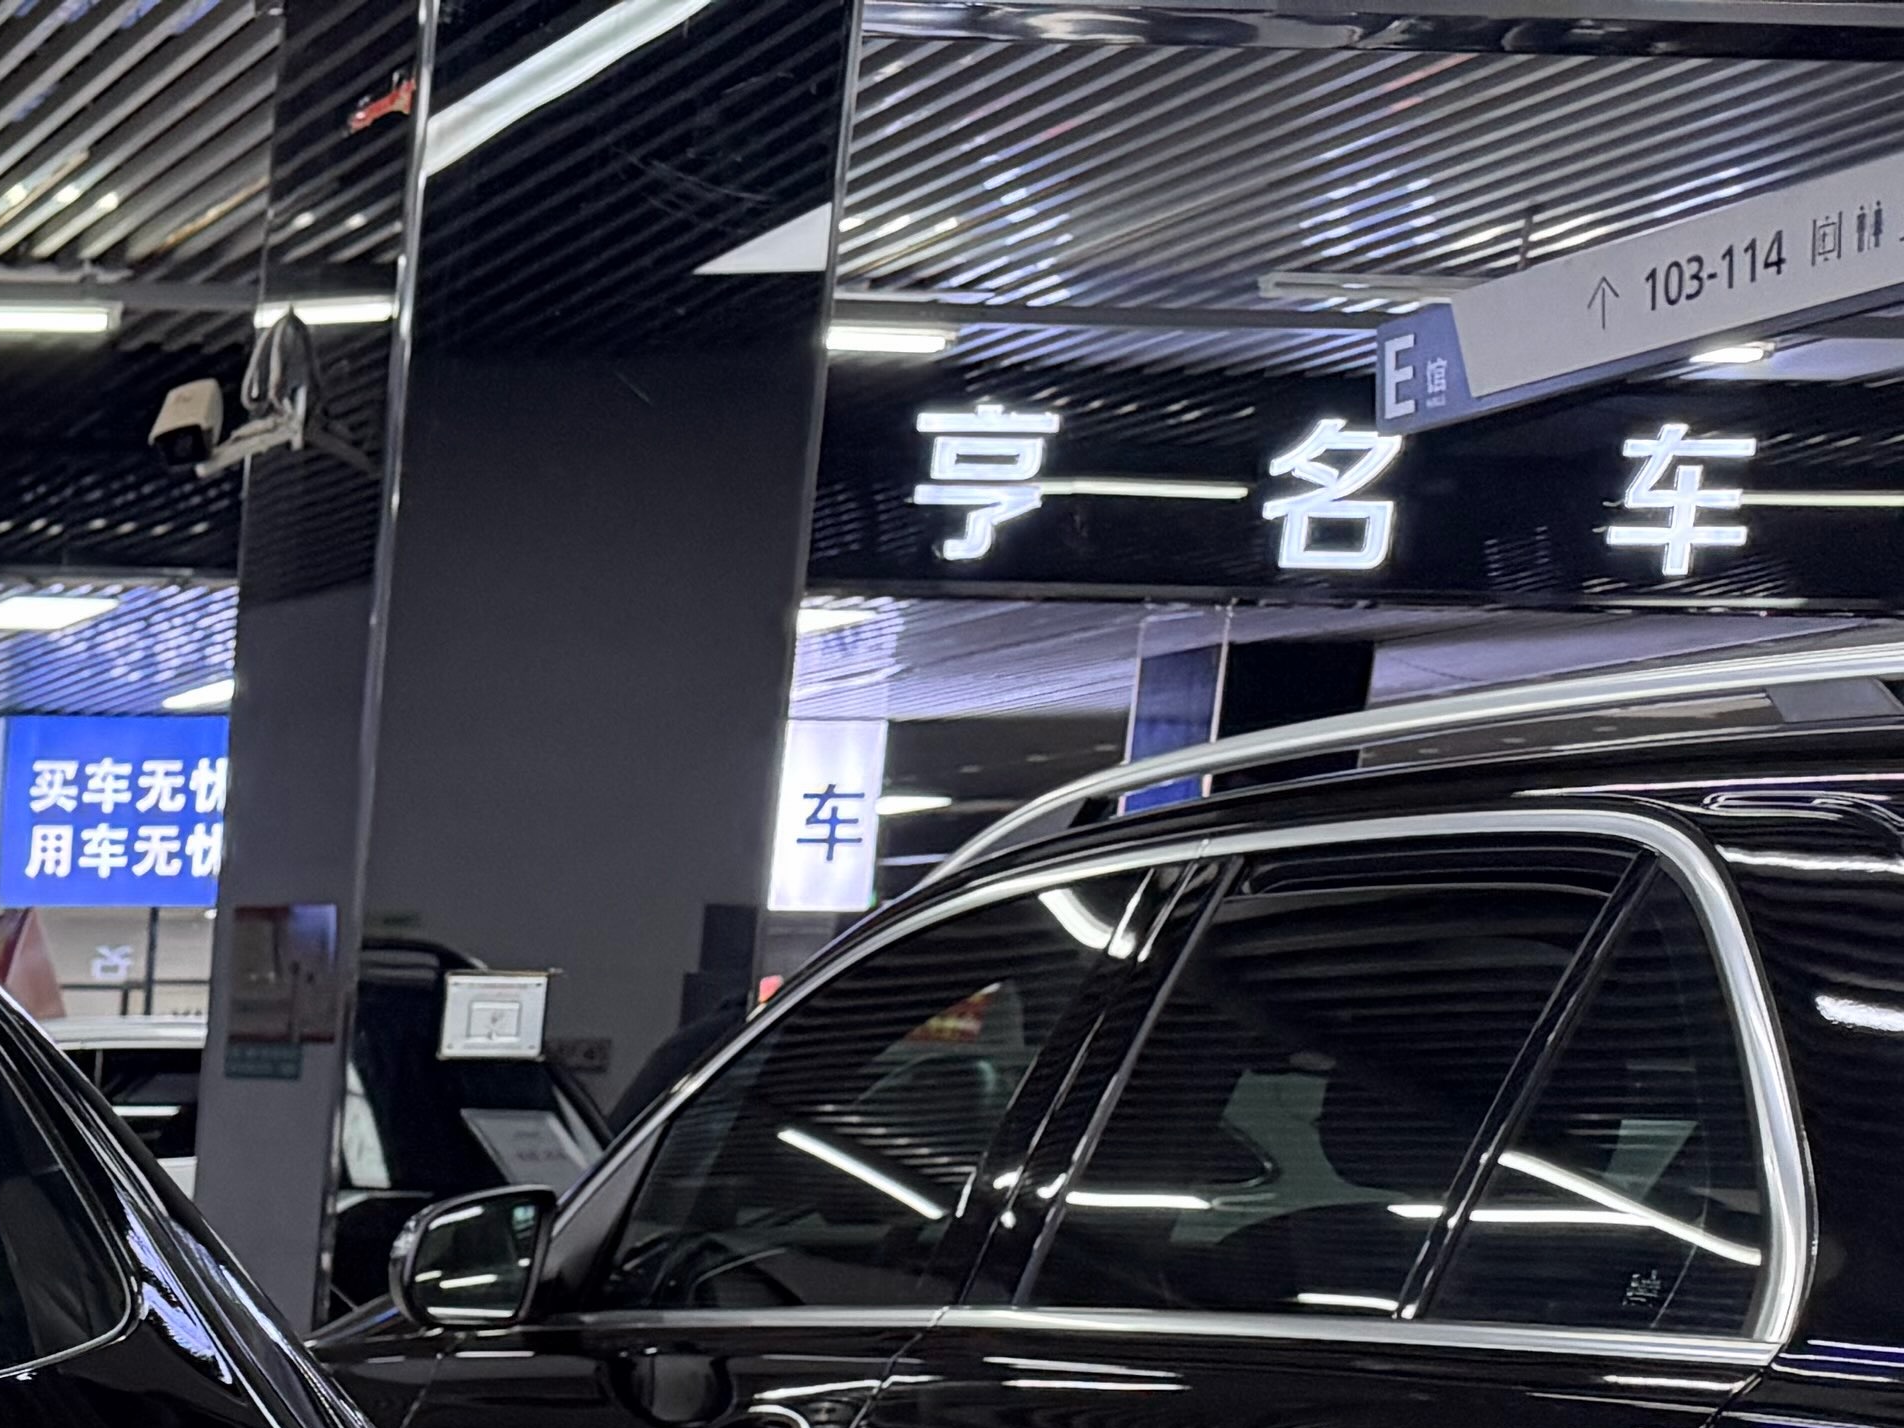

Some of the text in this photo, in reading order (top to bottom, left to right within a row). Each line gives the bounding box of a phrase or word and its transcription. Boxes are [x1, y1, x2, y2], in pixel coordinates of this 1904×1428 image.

[1644, 229, 1787, 311] 103-114
[1384, 333, 1416, 419] E
[795, 783, 866, 862] 车
